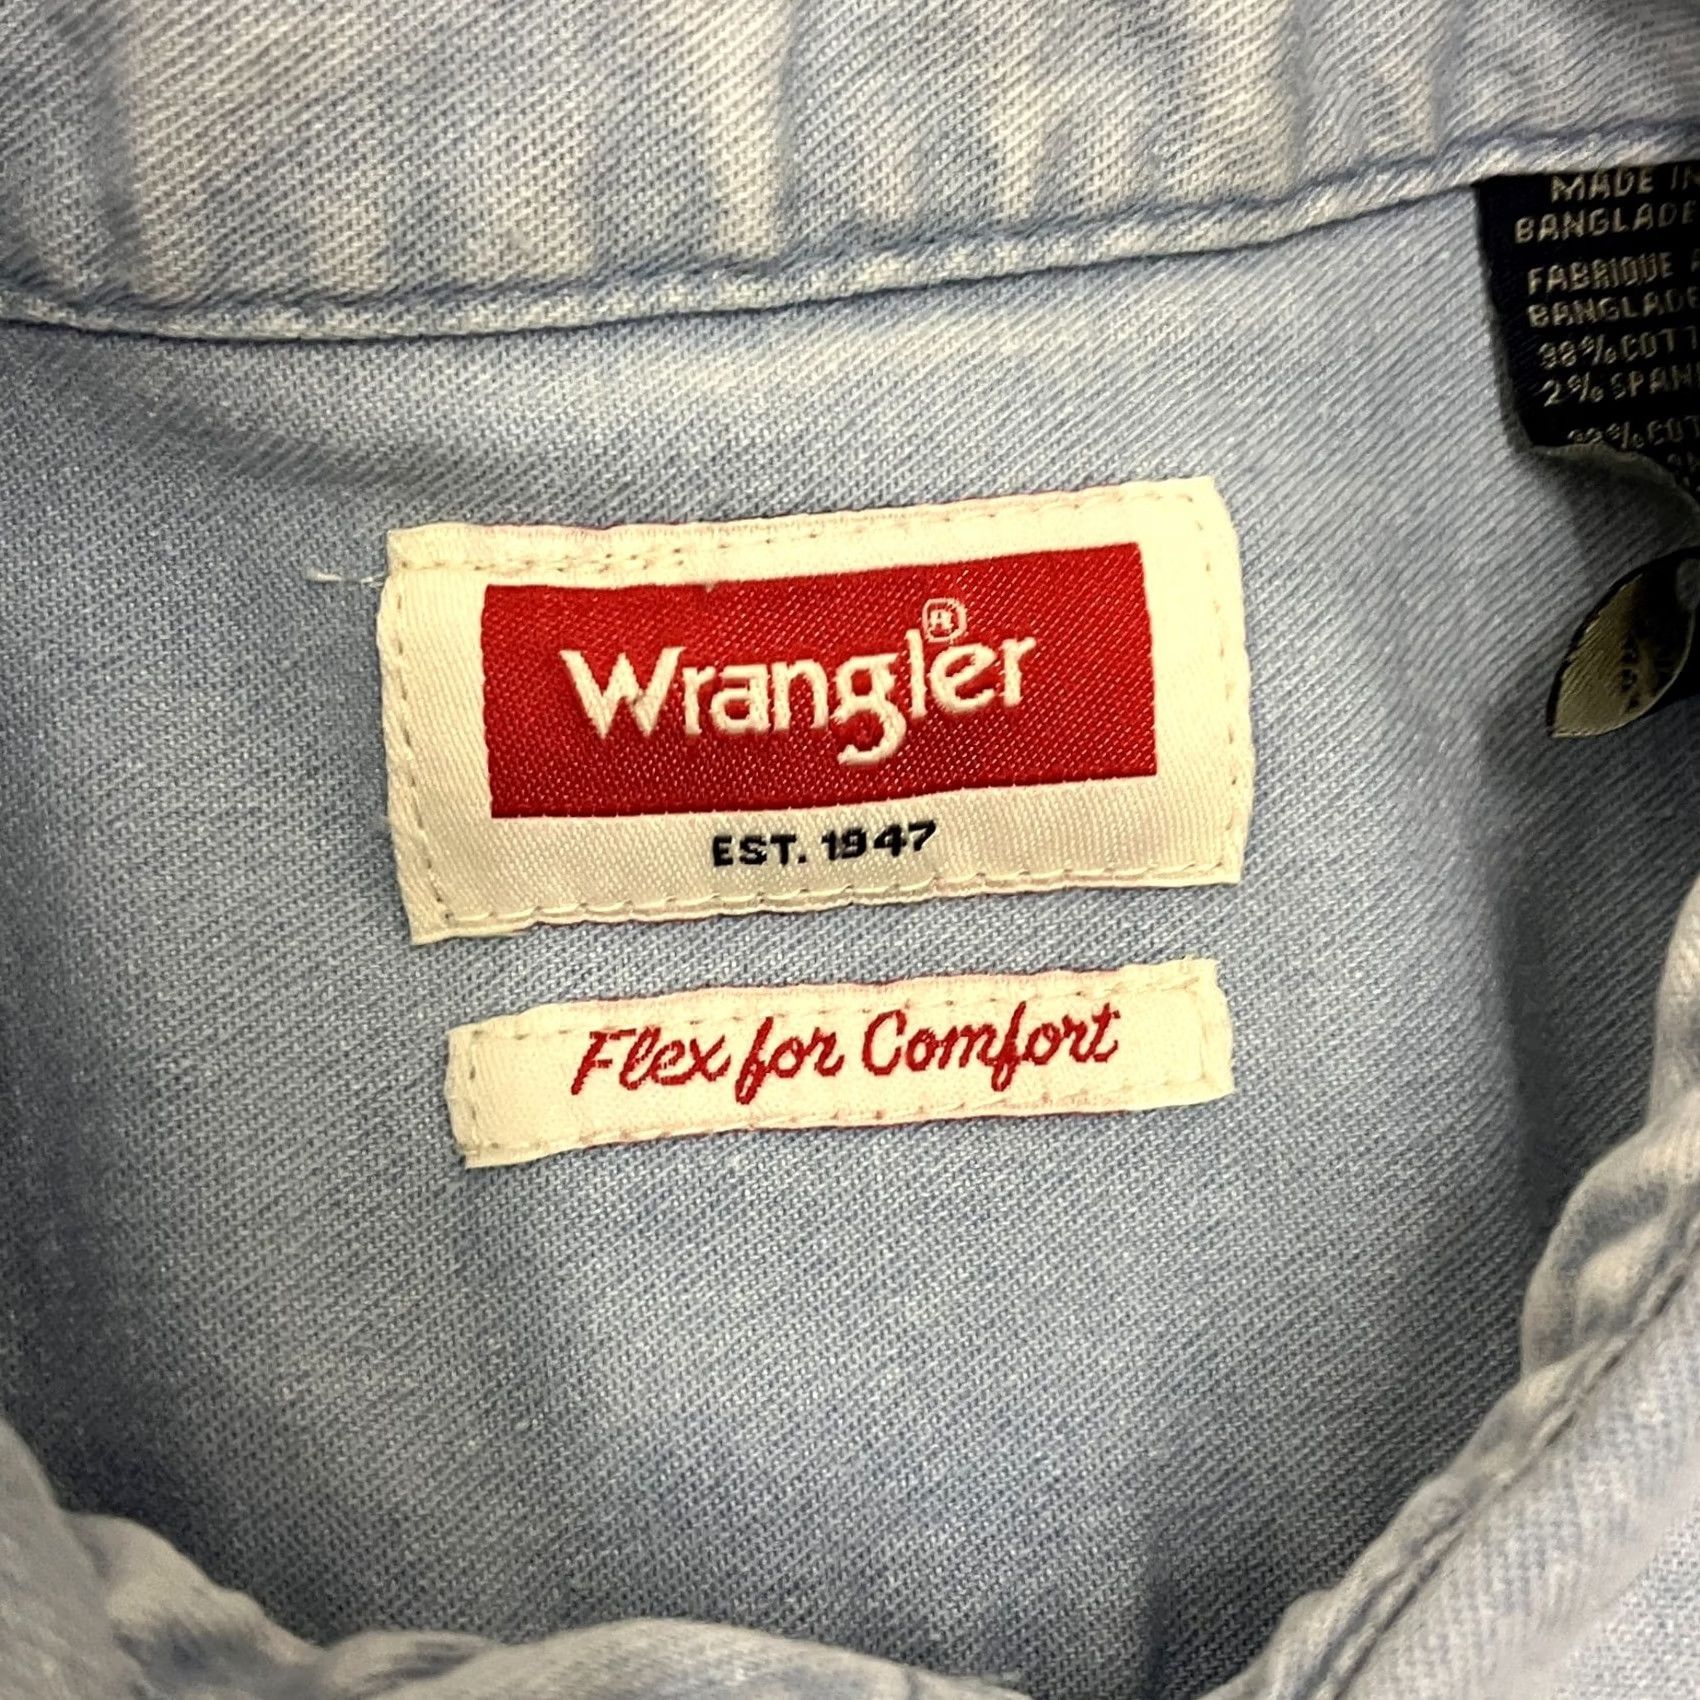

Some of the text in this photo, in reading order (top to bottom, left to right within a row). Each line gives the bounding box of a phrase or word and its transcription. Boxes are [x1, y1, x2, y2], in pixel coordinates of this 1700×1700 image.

[1551, 166, 1654, 202] MADE
[1514, 200, 1697, 243] BANGLADE
[1527, 252, 1674, 295] FABRIQUE
[559, 628, 1038, 766] Wrangler
[712, 820, 938, 868] EST. 1947
[570, 1001, 1121, 1106] Flex for Comfort
